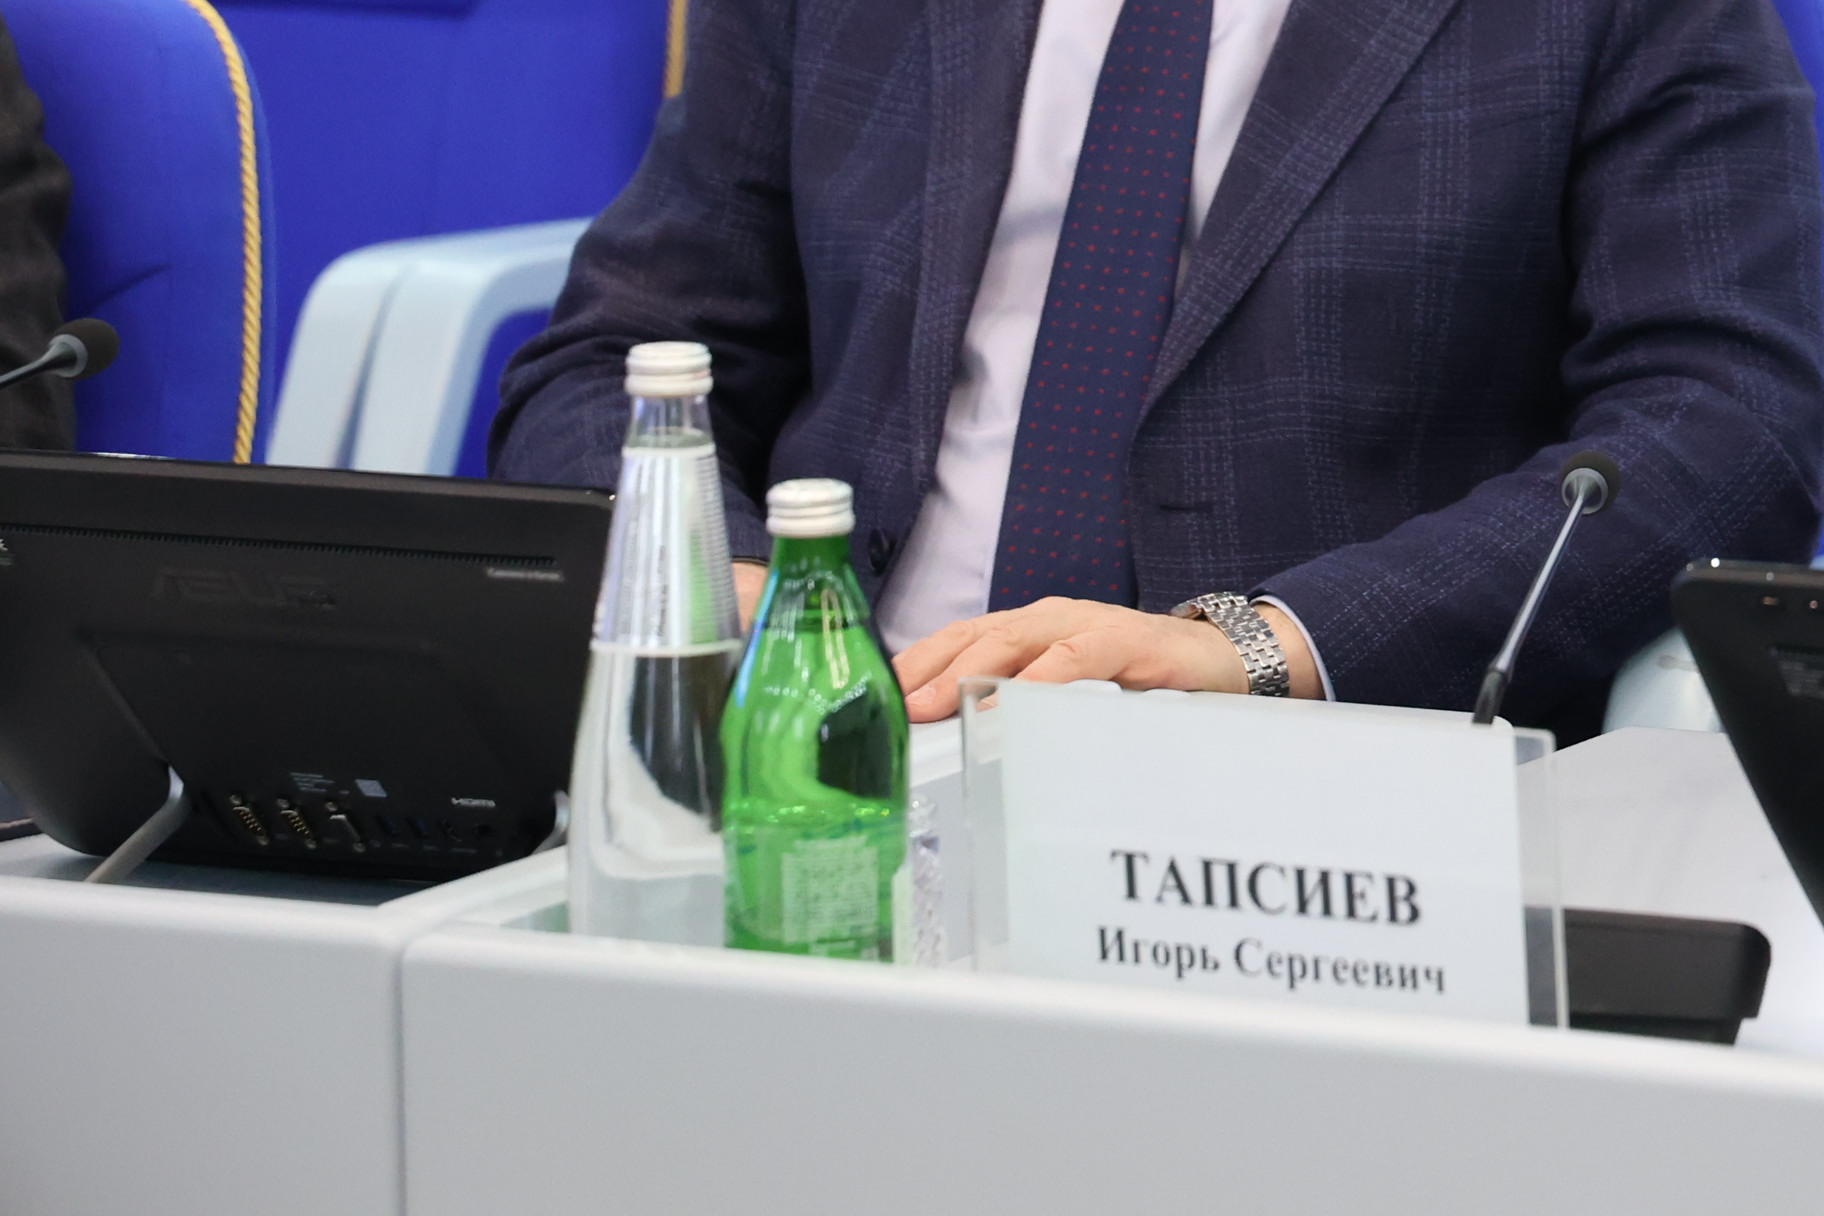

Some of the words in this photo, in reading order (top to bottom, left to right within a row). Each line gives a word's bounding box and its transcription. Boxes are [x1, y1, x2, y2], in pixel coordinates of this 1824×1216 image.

[1110, 850, 1421, 925] ТАПСИЕВ
[1098, 926, 1220, 979] Игорь
[1234, 938, 1446, 994] Сергеевич
